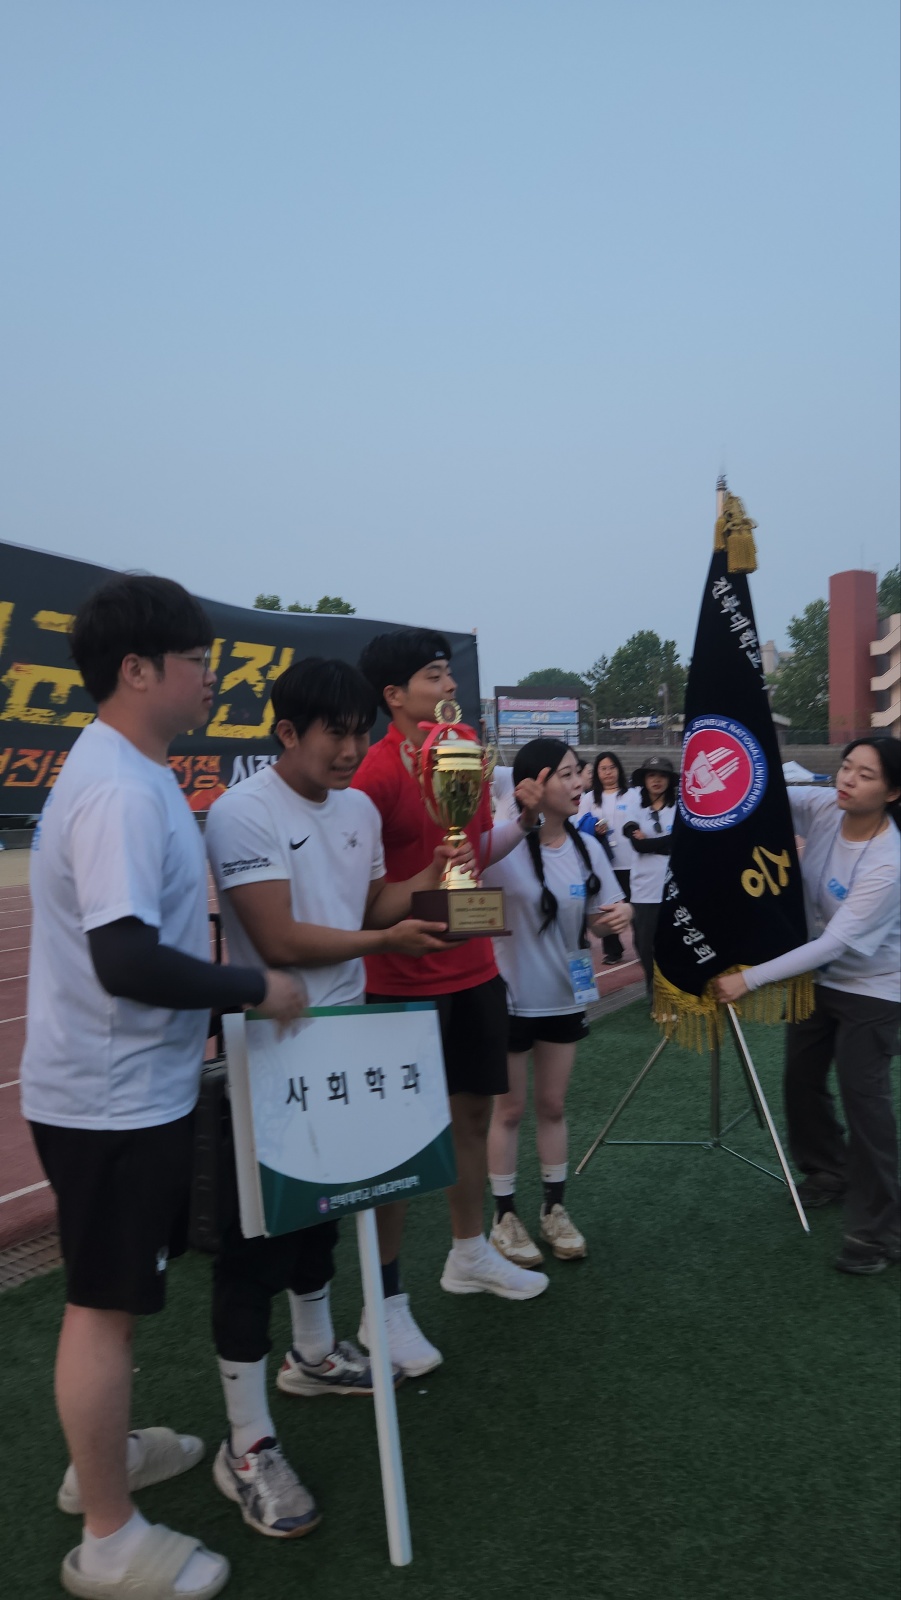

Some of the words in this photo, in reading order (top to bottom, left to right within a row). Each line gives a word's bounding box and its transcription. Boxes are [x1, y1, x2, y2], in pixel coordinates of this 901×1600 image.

[727, 723, 762, 761] NATIONAL
[740, 762, 765, 813] UNIVERSITY
[673, 905, 717, 964] 학생회
[285, 1062, 420, 1112] 사회학과
